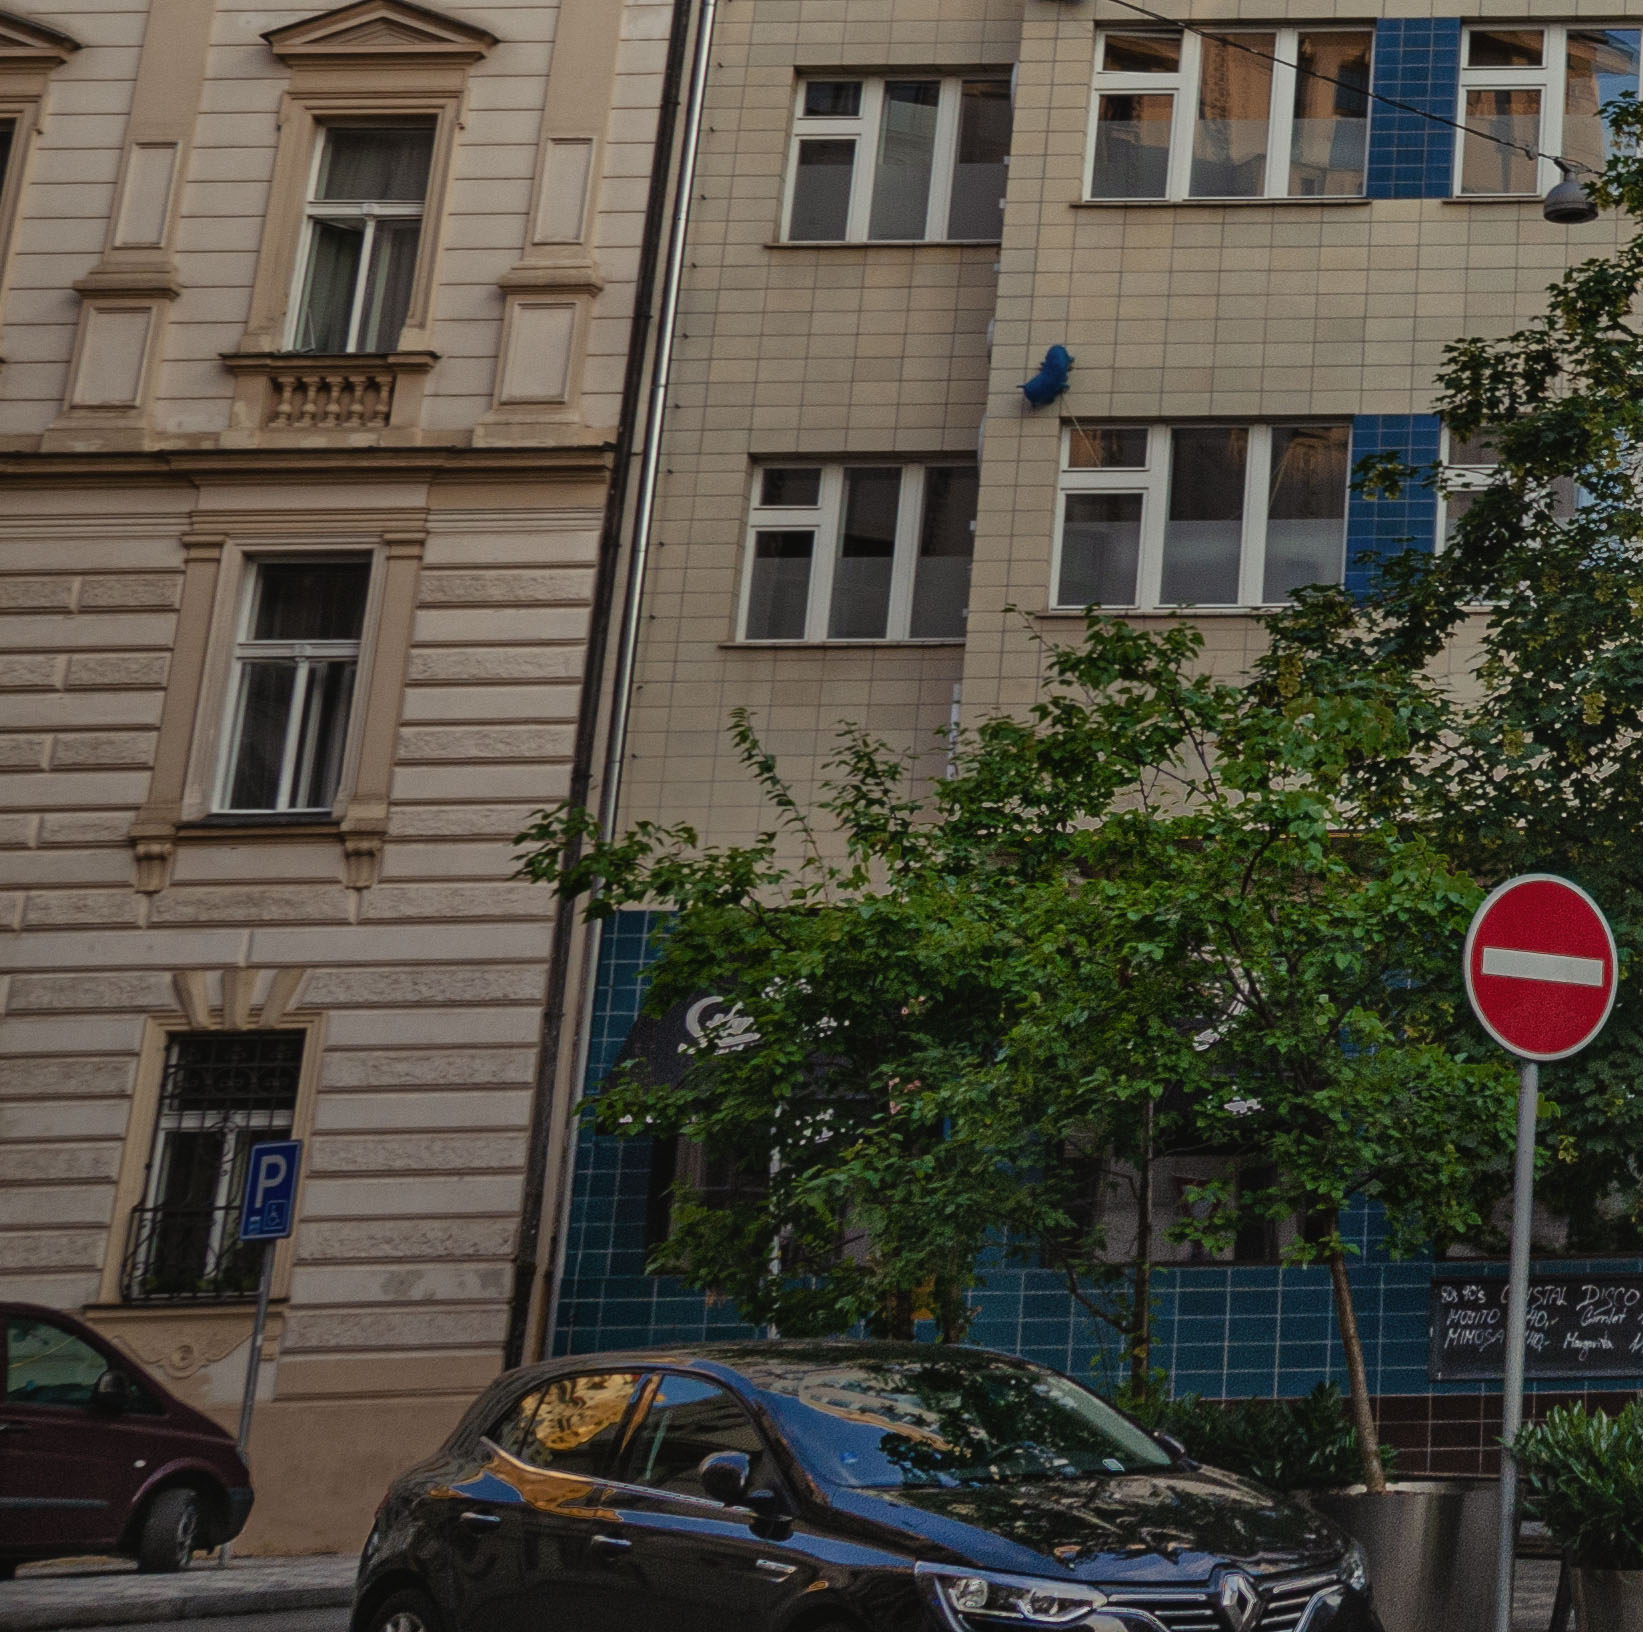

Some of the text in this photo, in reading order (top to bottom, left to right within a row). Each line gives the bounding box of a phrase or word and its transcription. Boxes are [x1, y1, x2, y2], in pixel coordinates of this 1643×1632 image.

[254, 1155, 289, 1209] P
[1576, 1284, 1641, 1315] DISCO
[1443, 1328, 1507, 1353] MIMOSA
